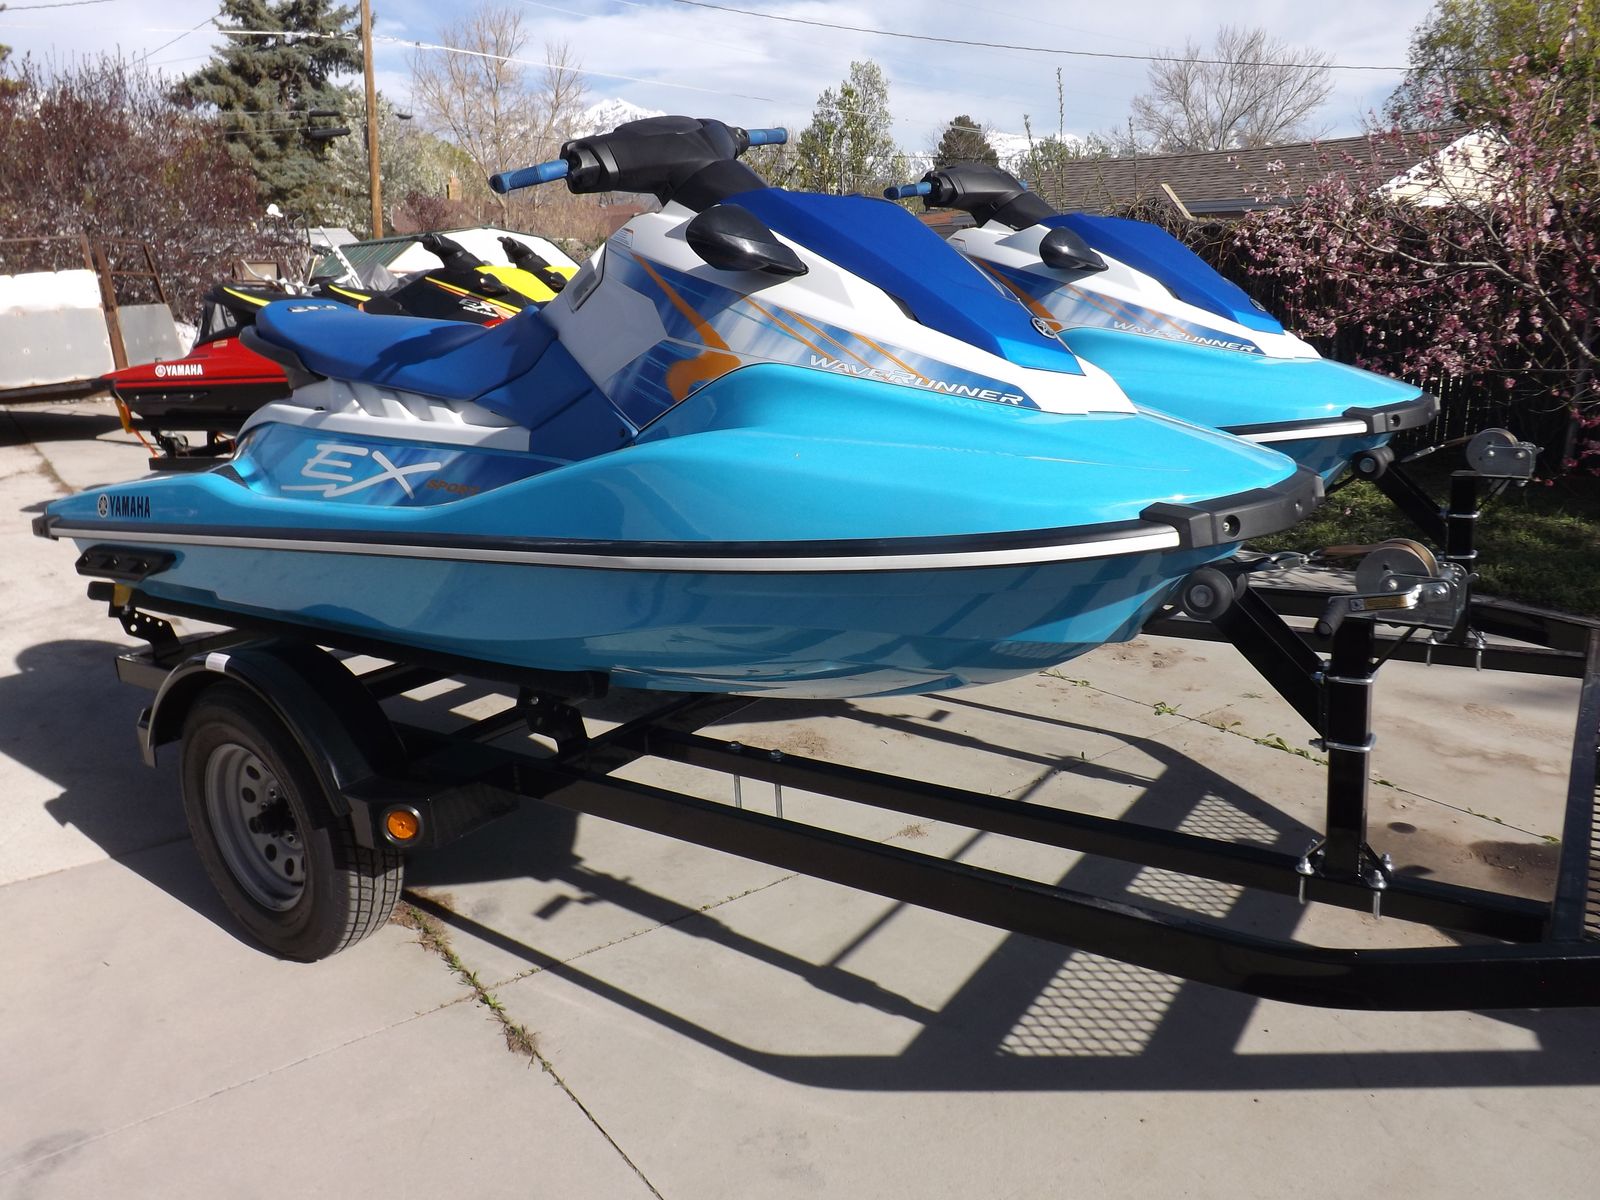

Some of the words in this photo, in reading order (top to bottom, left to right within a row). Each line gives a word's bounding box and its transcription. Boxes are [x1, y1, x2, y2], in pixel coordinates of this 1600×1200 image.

[165, 363, 204, 377] YAMAHA
[810, 354, 1024, 406] WAVERUNNER
[281, 444, 442, 499] EX
[109, 495, 151, 518] YAMAHA
